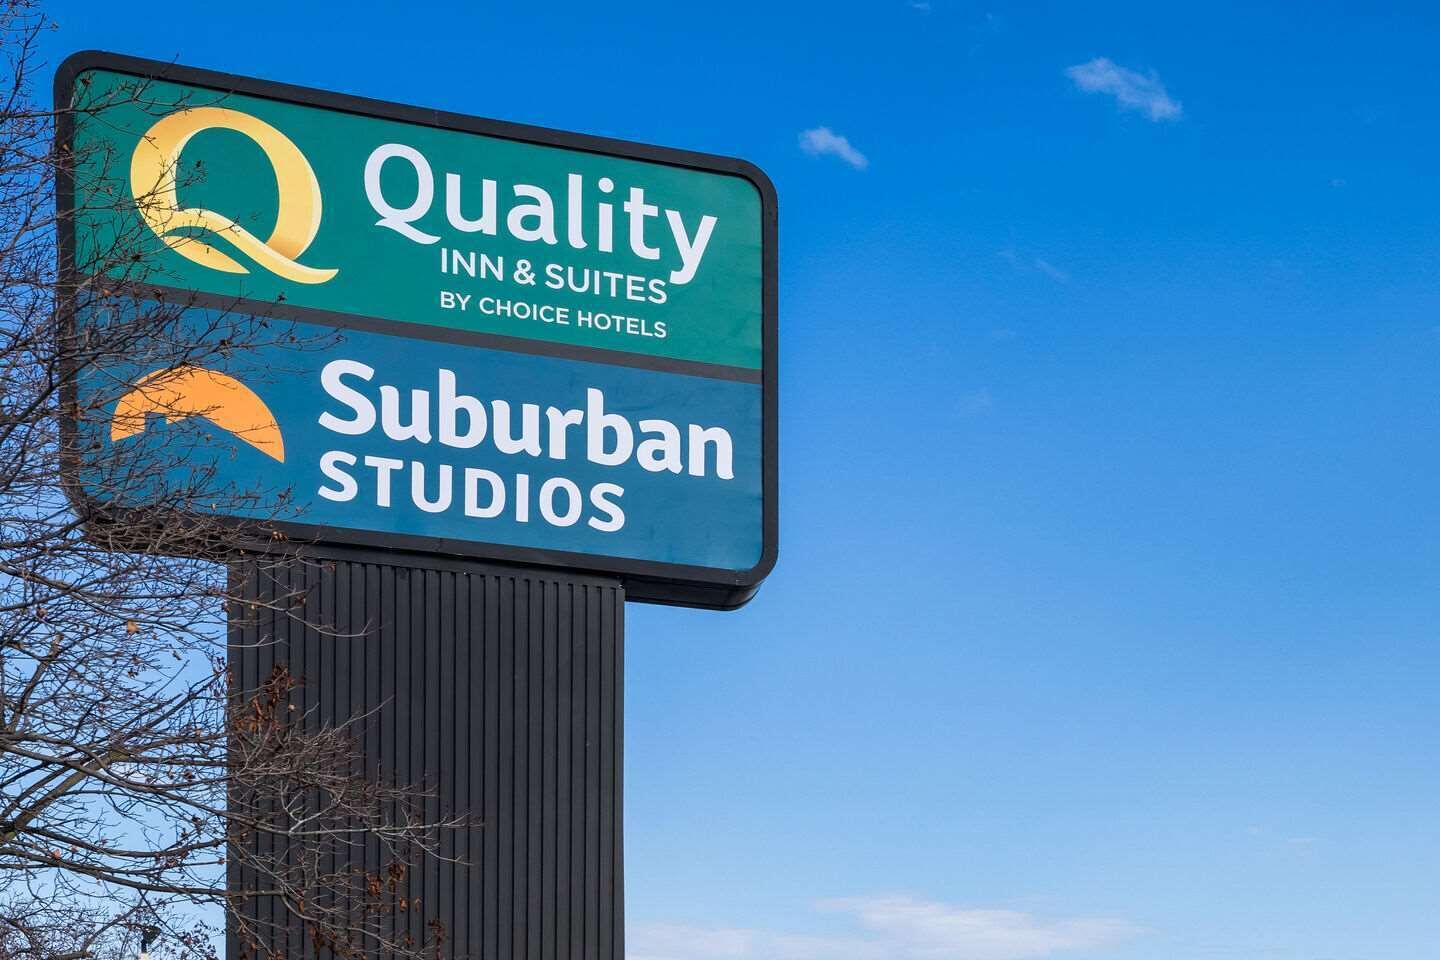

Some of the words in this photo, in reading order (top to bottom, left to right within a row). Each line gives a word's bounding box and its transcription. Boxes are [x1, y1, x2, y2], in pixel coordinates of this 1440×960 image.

[129, 106, 339, 285] Q
[363, 142, 718, 285] Quality
[439, 290, 472, 311] BY
[478, 297, 570, 326] CHOICE
[577, 310, 667, 338] HOTELS
[440, 247, 505, 281] INN
[512, 258, 537, 287] &
[544, 262, 669, 305] SUITES
[317, 359, 735, 481] Suburban
[317, 449, 627, 533] STUDIOS
